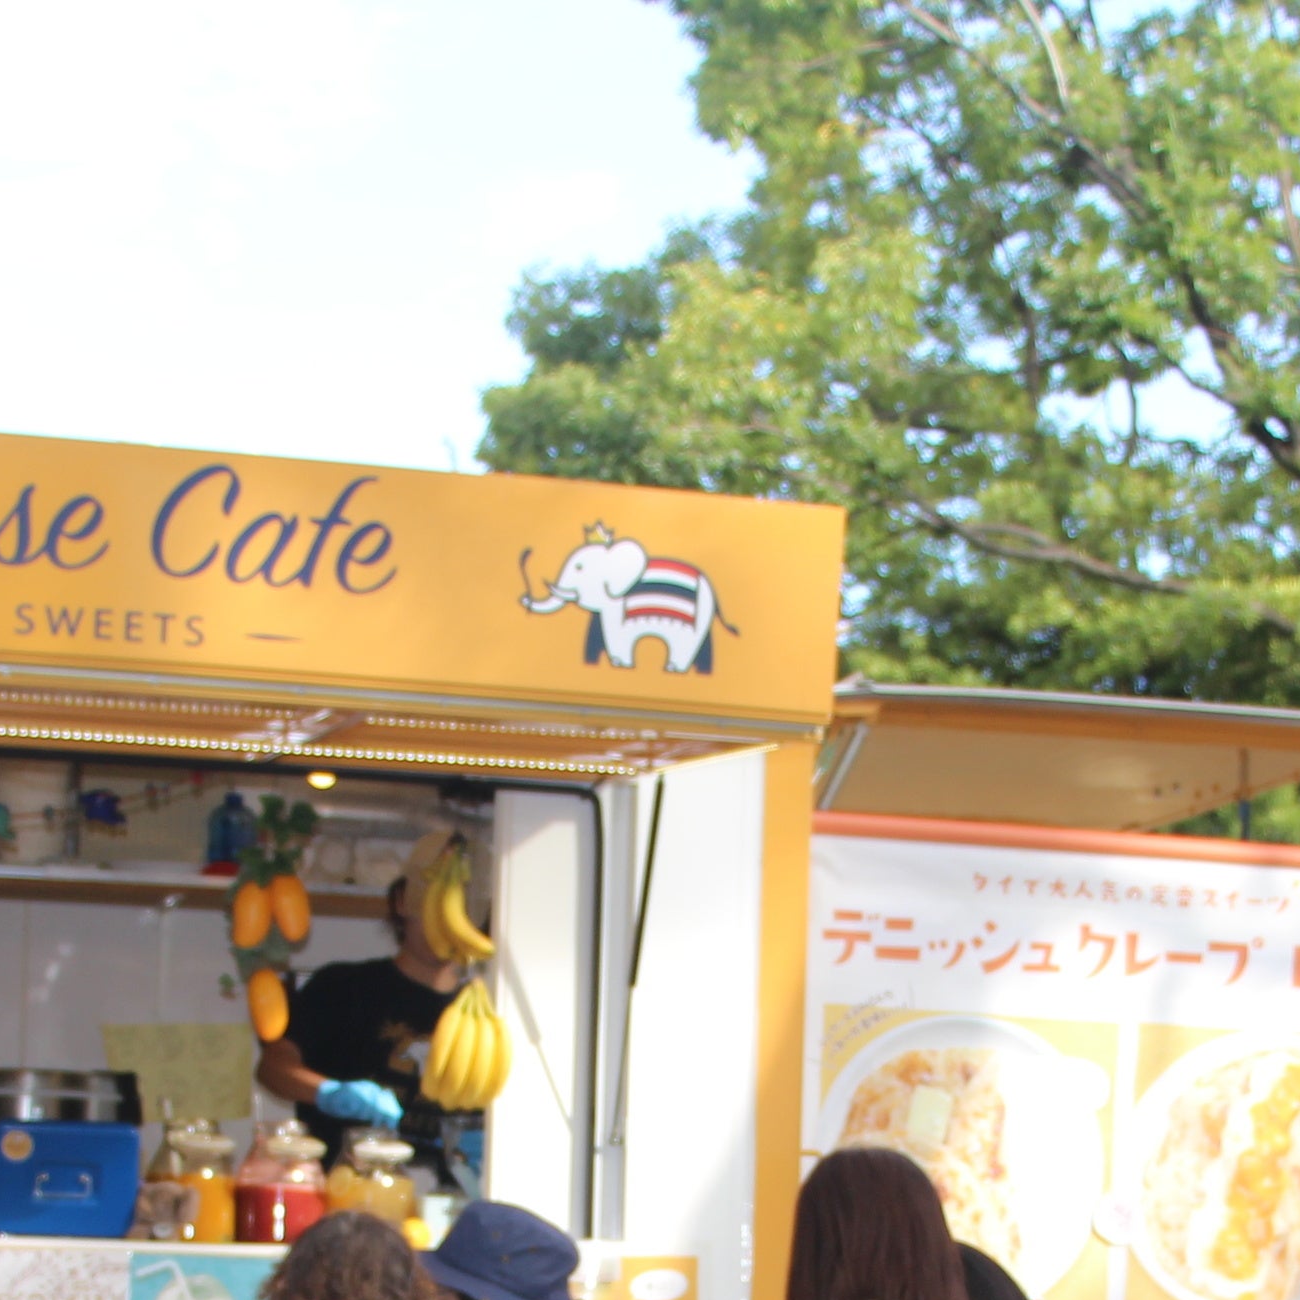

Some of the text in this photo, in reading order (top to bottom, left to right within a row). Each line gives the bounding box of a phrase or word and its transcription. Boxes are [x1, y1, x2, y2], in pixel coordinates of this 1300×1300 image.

[150, 463, 398, 594] Cafe
[14, 602, 207, 647] SWEETS
[822, 908, 1266, 986] デニッシュクレープ
